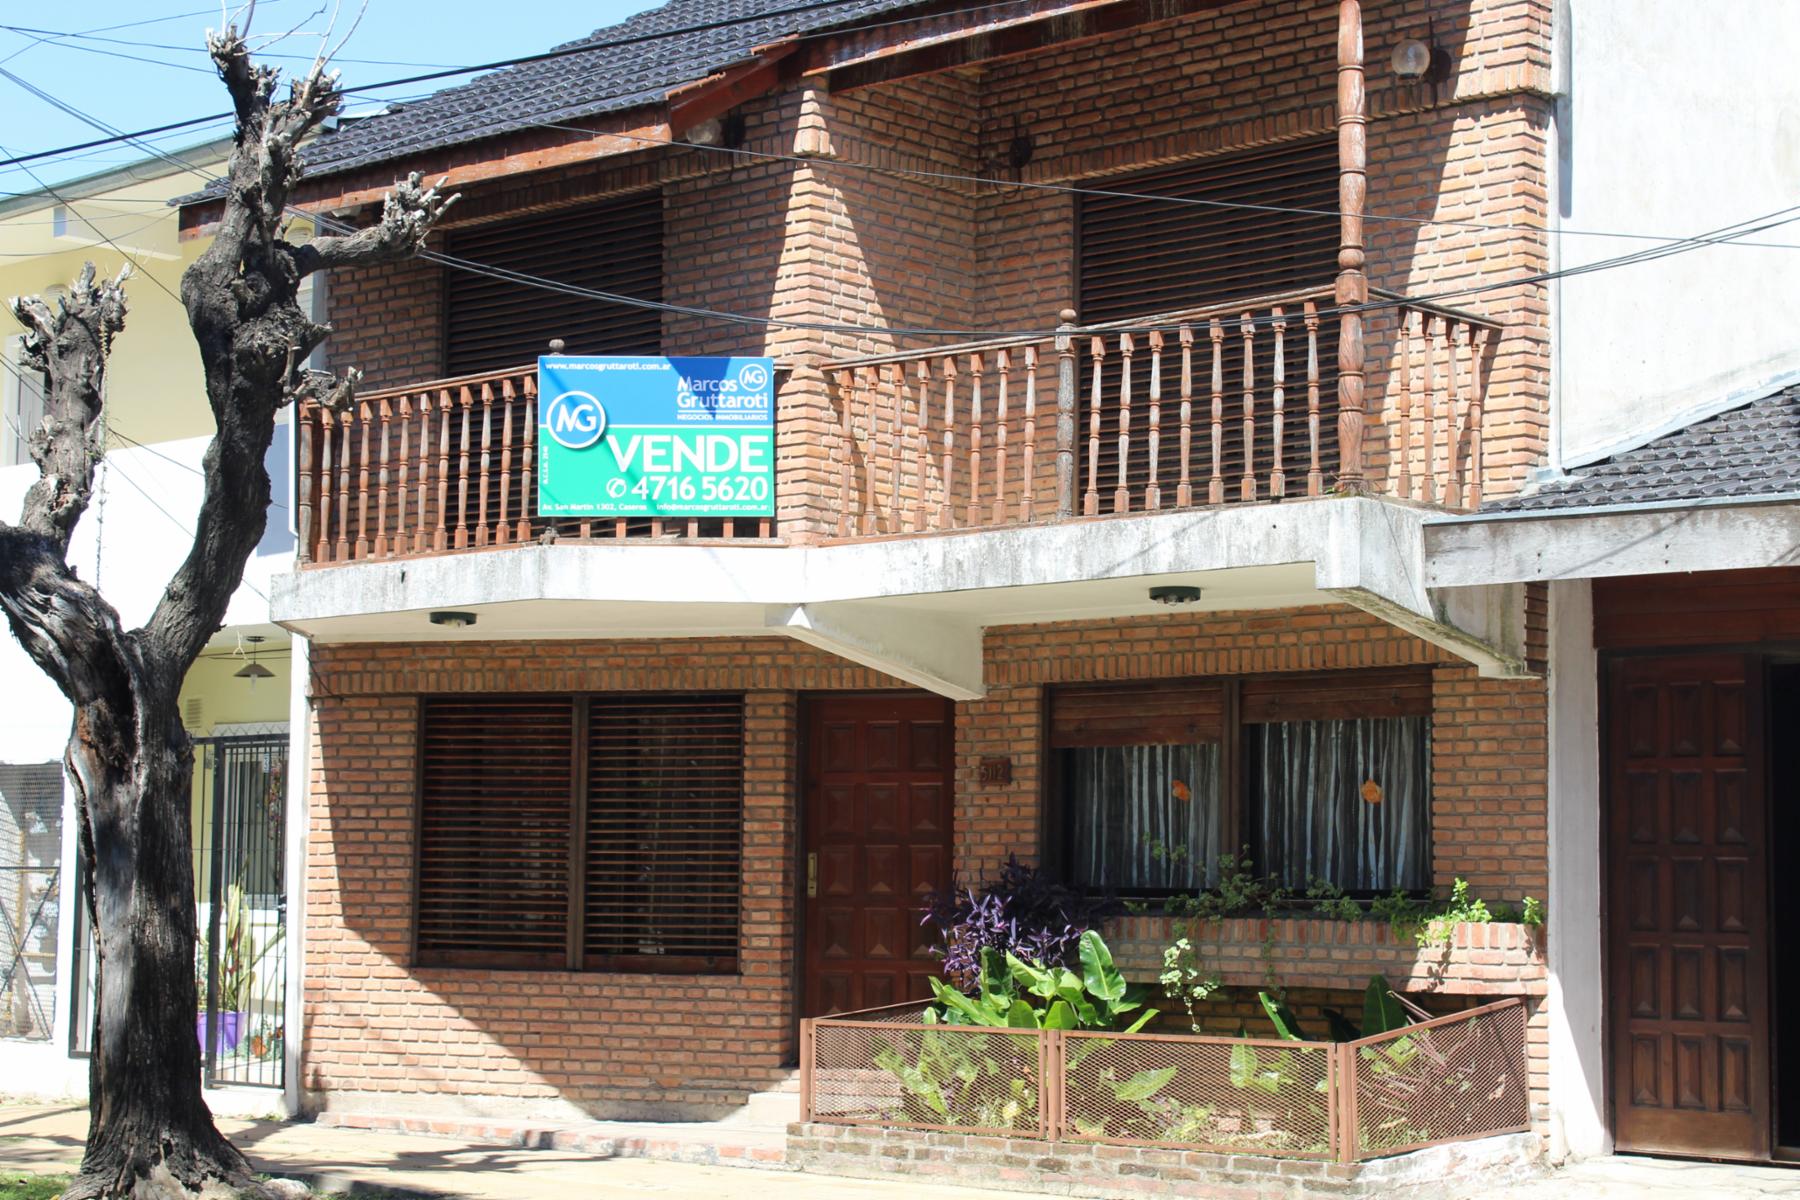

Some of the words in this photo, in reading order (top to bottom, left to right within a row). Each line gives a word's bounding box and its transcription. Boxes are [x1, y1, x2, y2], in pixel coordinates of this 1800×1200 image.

[677, 376, 738, 392] Marcos
[677, 392, 768, 409] Gruttaroti
[606, 435, 769, 473] VENDE
[631, 476, 696, 500] 4716
[702, 476, 768, 500] 5620
